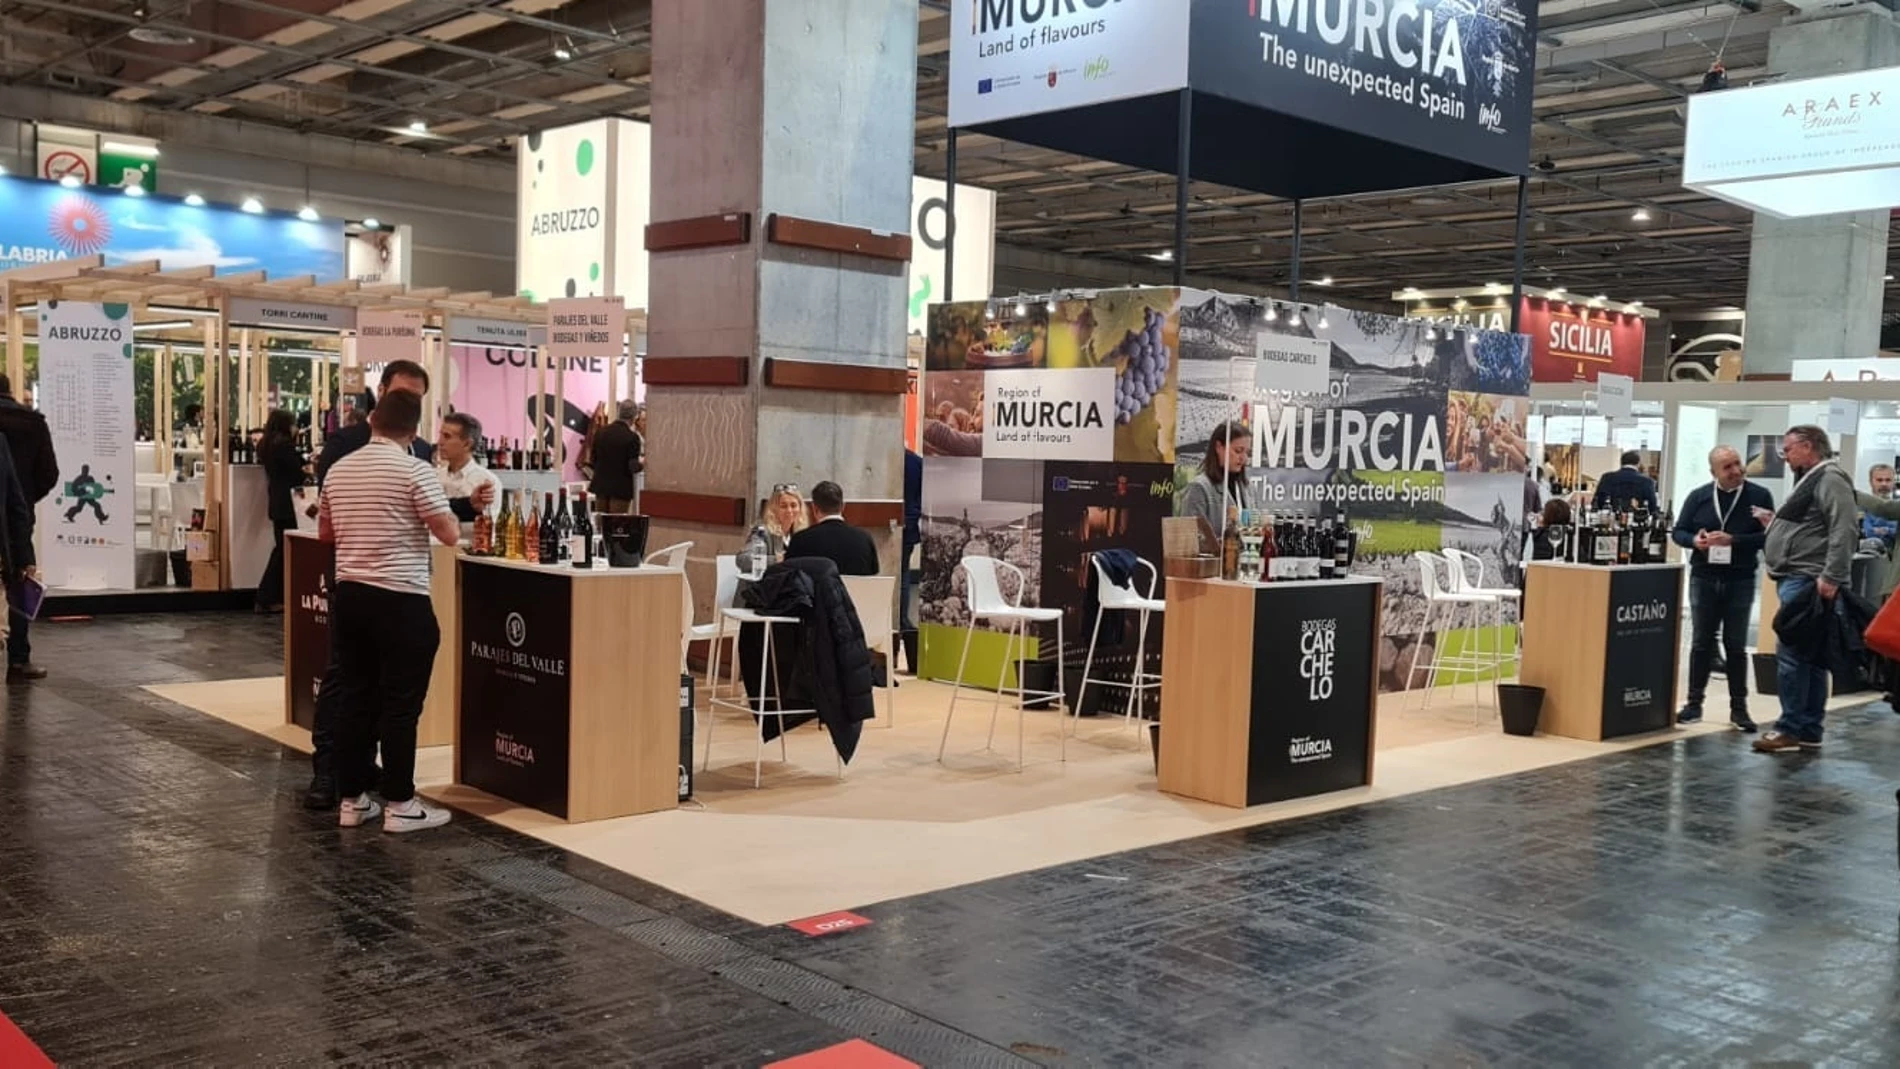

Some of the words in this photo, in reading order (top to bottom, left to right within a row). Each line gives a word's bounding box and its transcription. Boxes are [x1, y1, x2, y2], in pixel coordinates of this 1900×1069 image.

[979, 37, 1013, 58] Land
[1019, 30, 1036, 50] of
[1041, 18, 1106, 45] flavours
[1260, 32, 1297, 69] The
[1304, 53, 1414, 105] unexpected
[1419, 83, 1465, 119] Spain
[1478, 102, 1502, 131] info
[1782, 91, 1882, 117] ARAEX
[531, 206, 600, 236] ABRUZZO
[0, 243, 68, 263] LABRIA
[261, 308, 288, 319] TORRI
[290, 311, 329, 321] CANTINE
[553, 315, 578, 326] PARAJES
[578, 314, 590, 326] DEL
[590, 314, 608, 326] VALLE
[49, 325, 122, 342] ABRUZZO
[476, 325, 505, 336] TENUTA
[553, 331, 579, 344] BODEGAS
[580, 332, 585, 343] Y
[585, 329, 609, 343] VIÑEDOS
[1549, 321, 1613, 356] SICILIA
[998, 387, 1030, 400] Region
[1330, 372, 1350, 400] of
[996, 401, 1103, 429] MURCIA
[996, 431, 1019, 443] Land
[1020, 431, 1031, 443] of
[1032, 432, 1072, 444] flavours
[1250, 404, 1445, 472] MURCIA
[1250, 475, 1286, 500] The
[1292, 477, 1395, 508] unexpected
[1401, 479, 1445, 508] Spain
[301, 595, 312, 609] LA
[1616, 599, 1667, 623] CASTAÑO
[1301, 618, 1337, 632] BODEGAS
[1300, 630, 1336, 655] CAR
[471, 640, 511, 665] PARAJES
[512, 651, 531, 668] DEL
[531, 655, 565, 676] VALLE
[1300, 652, 1334, 678] CHE
[1310, 676, 1333, 701] LO
[495, 737, 535, 764] MURCIA
[1290, 739, 1332, 757] MURCIA
